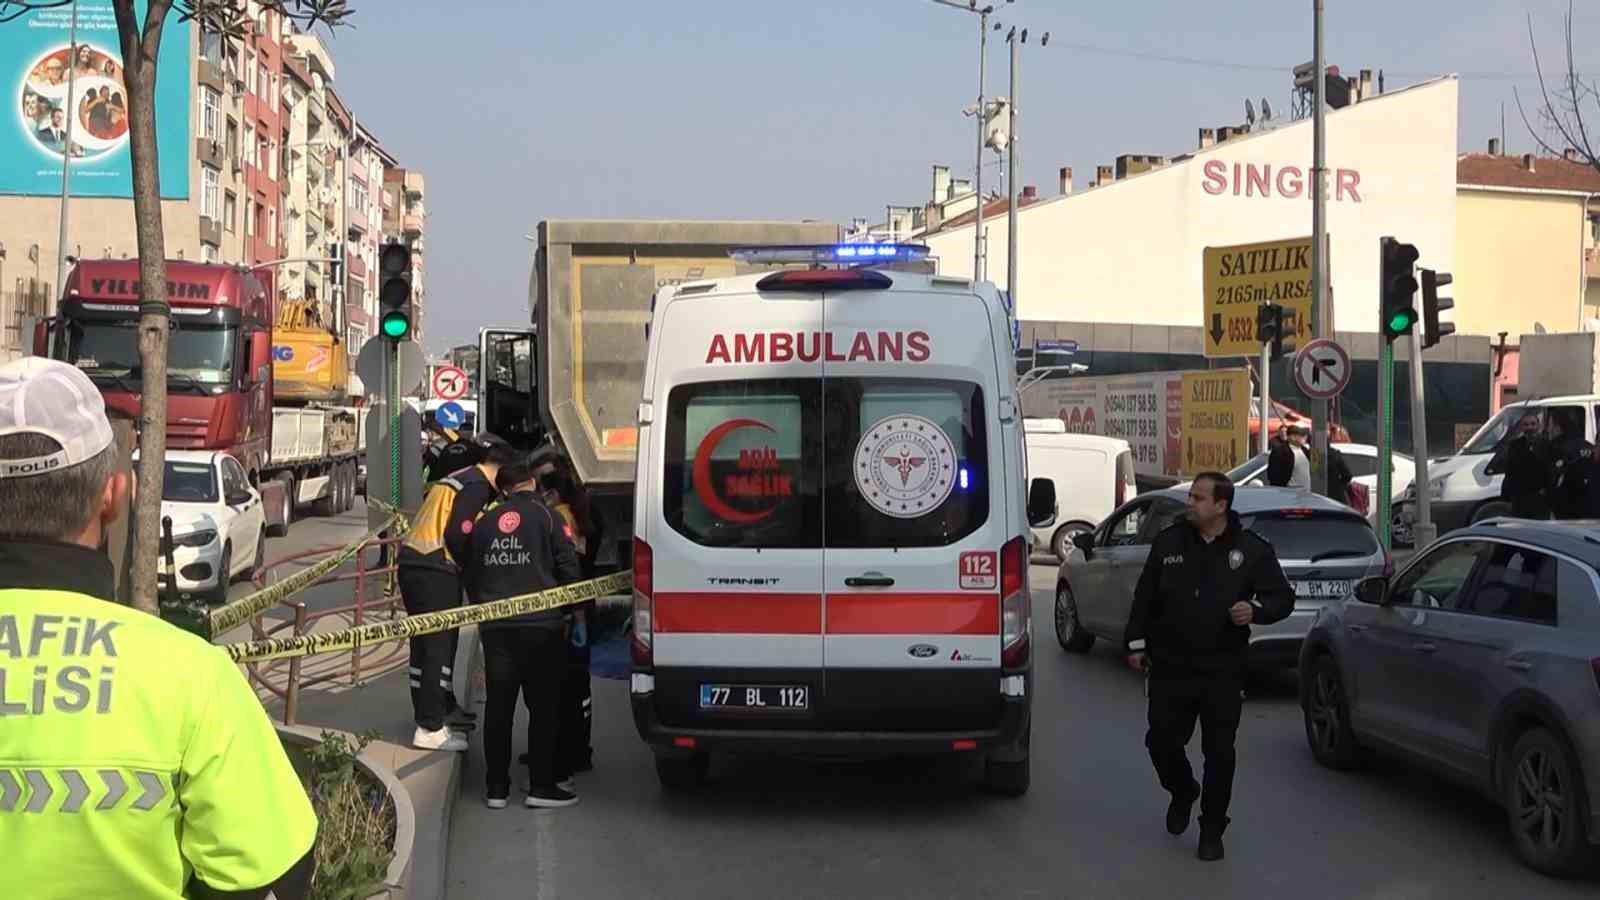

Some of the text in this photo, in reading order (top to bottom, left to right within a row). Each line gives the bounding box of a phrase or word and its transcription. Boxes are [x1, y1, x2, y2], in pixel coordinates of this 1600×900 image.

[1220, 245, 1311, 277] SATILIK
[705, 331, 931, 364] AMBULANS
[490, 535, 523, 550] ACİL
[964, 555, 992, 574] 112
[712, 688, 805, 706] 77 BL 112
